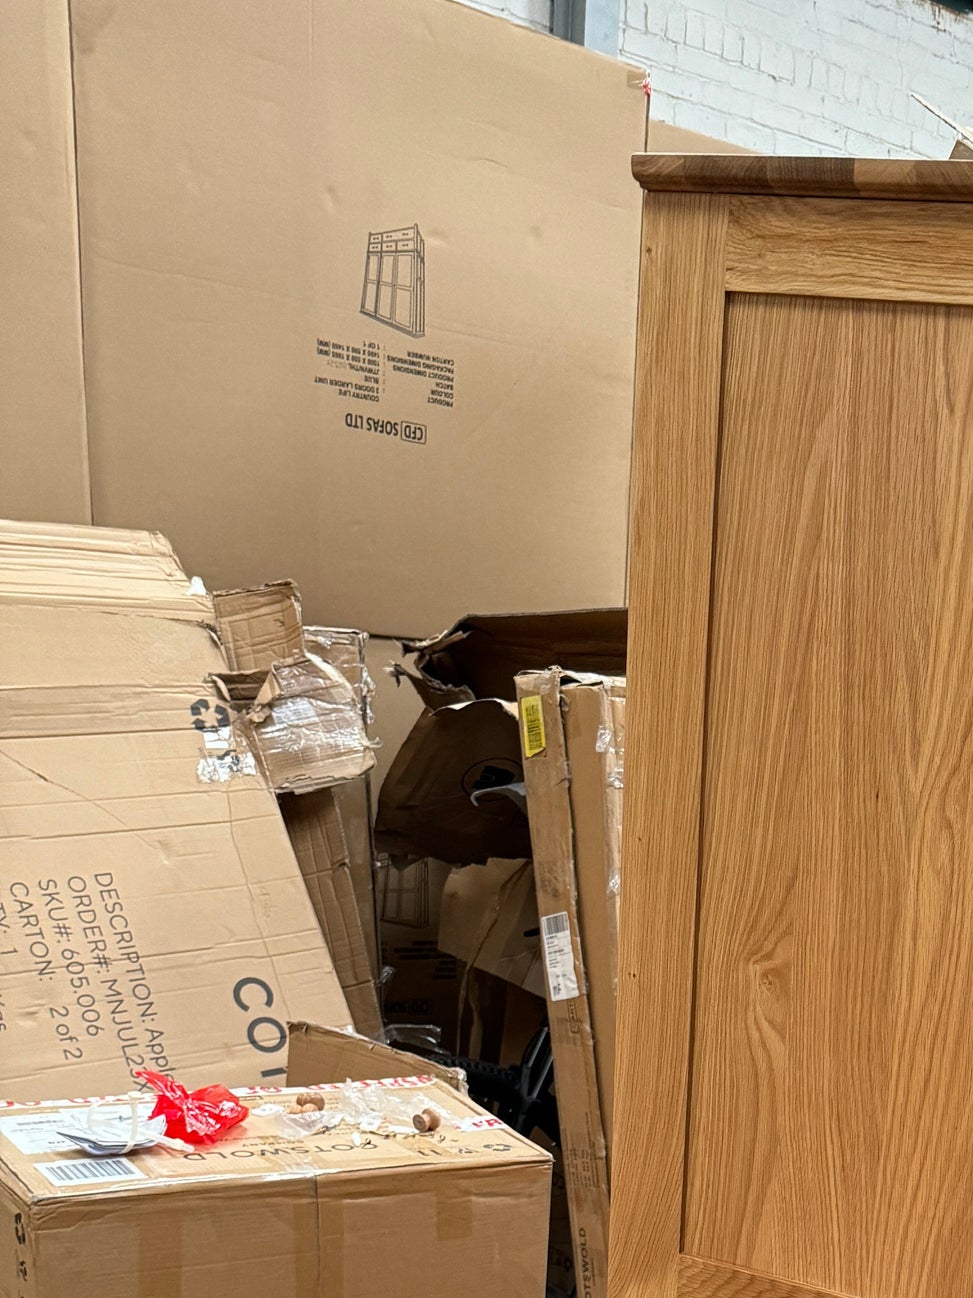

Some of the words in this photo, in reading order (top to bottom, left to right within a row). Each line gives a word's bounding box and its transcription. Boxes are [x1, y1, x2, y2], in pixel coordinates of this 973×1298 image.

[387, 355, 421, 367] DIMENSIONS
[407, 351, 431, 361] NUMBER
[431, 356, 455, 366] CARTON
[393, 365, 427, 377] DIMENSIONS
[422, 362, 454, 374] PACKAGING
[364, 375, 380, 384] BLUE
[428, 371, 454, 382] PRODUCT
[329, 380, 353, 389] LARDER
[354, 383, 375, 393] DOORS
[435, 382, 454, 390] BATCH
[338, 388, 352, 396] LIFE
[352, 391, 380, 402] COUNTRY
[431, 390, 454, 399] COLOUR
[427, 396, 454, 407] PRODUCT
[345, 413, 364, 429] LTD
[366, 417, 399, 436] SOFAS
[404, 425, 423, 440] CFD
[67, 876, 112, 974] ORDER#:
[10, 882, 56, 981] CARTON:
[94, 872, 158, 1024] DESCRIPTION:
[38, 879, 73, 944] SKU#:
[61, 949, 105, 1037] 605.006
[50, 1006, 70, 1019] 2
[56, 1023, 79, 1043] of
[64, 1047, 84, 1060] 2
[183, 1143, 378, 1161] COTSWOLD
